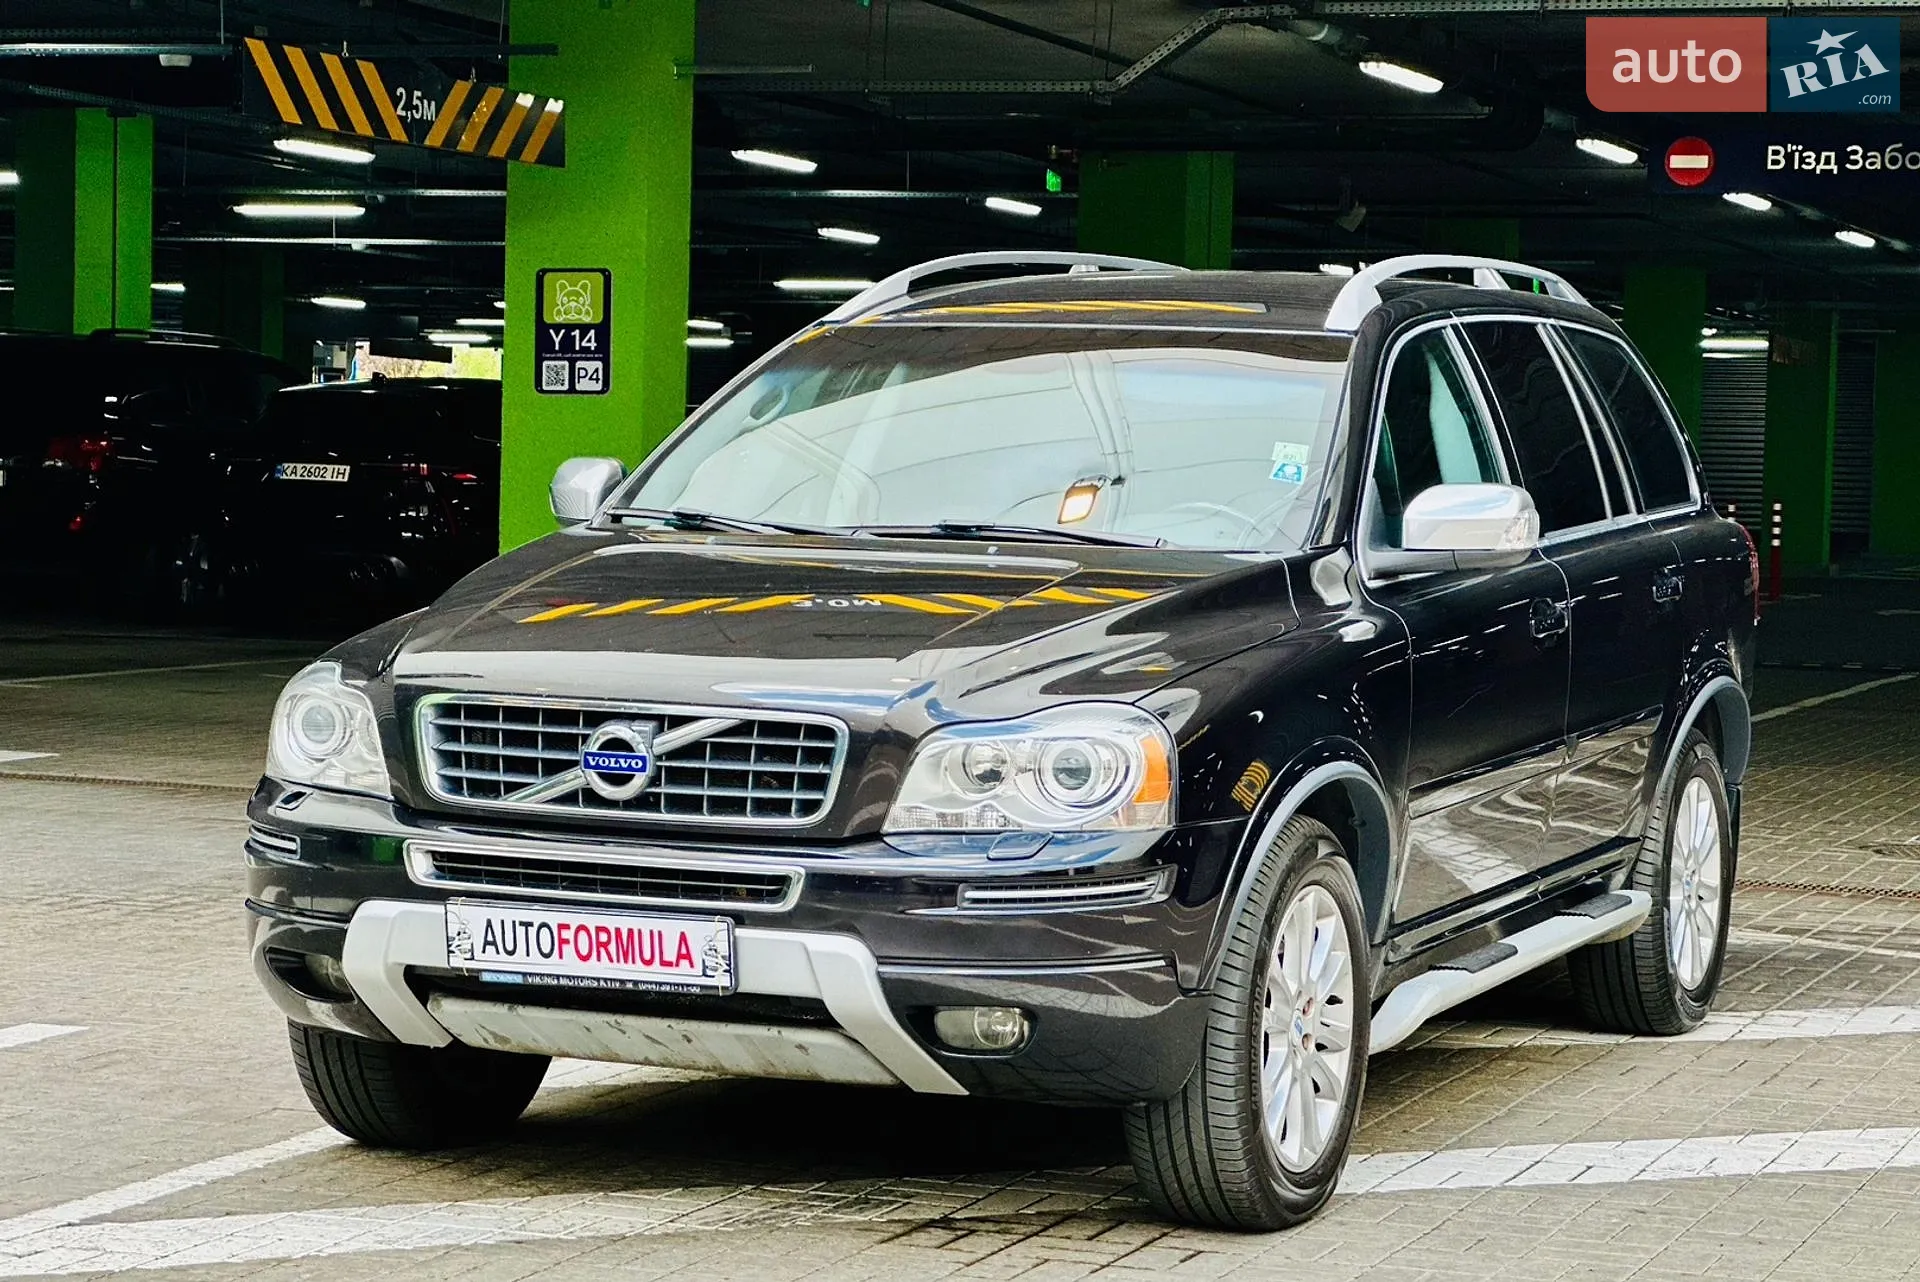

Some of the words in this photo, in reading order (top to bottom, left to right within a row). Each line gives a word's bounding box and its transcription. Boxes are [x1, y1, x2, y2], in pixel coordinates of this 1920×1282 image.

[1767, 143, 1838, 174] В'їзд
[549, 328, 566, 351] Y
[570, 328, 598, 351] 14
[577, 366, 601, 384] P4
[299, 465, 329, 479] 2602
[586, 755, 643, 769] VOLVO
[481, 917, 695, 969] AUTOFORMULA
